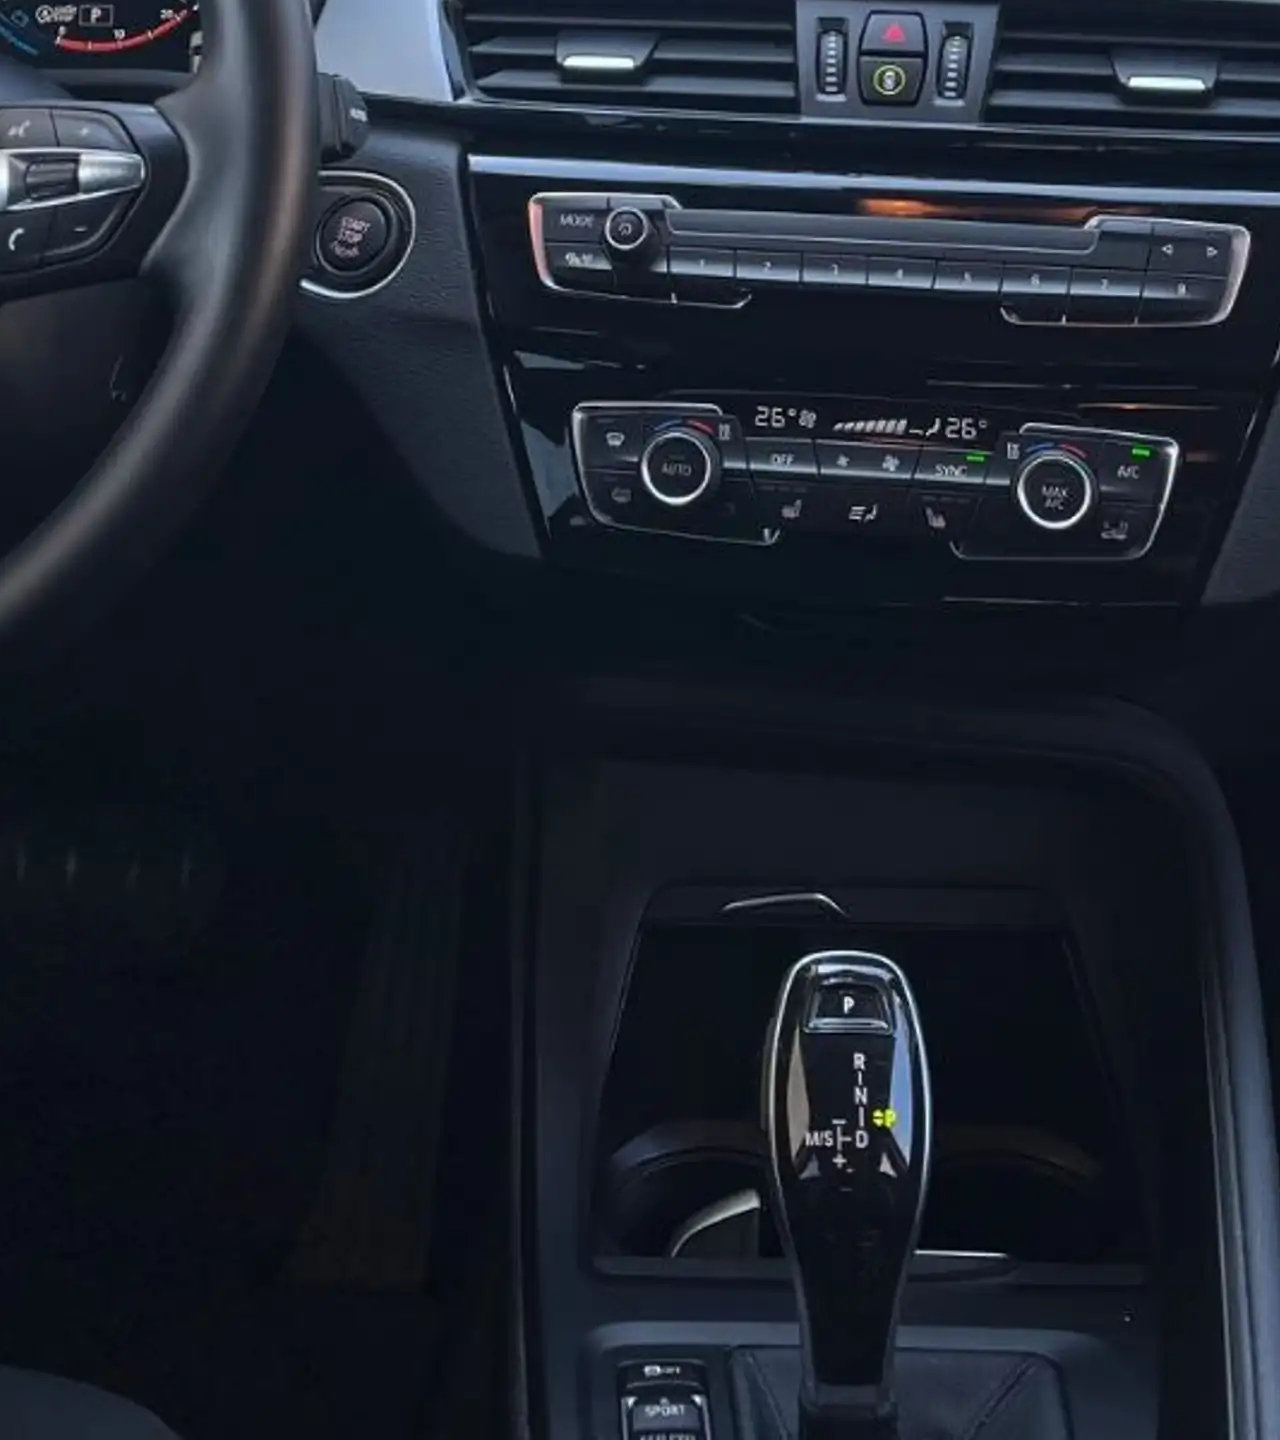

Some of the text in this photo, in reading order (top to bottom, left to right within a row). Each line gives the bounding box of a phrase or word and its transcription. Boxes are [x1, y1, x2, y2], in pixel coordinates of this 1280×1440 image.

[341, 215, 371, 232] START
[338, 227, 363, 244] STOP
[773, 453, 794, 466] OFF
[662, 463, 692, 477] AUTO
[935, 464, 968, 477] SYNC
[1117, 465, 1141, 479] A/C
[1041, 486, 1068, 498] MAX
[843, 996, 855, 1014] P
[853, 1052, 866, 1070] R
[854, 1087, 868, 1105] N
[805, 1131, 834, 1147] M/S
[855, 1131, 868, 1148] D
[644, 1403, 685, 1417] SPORT
